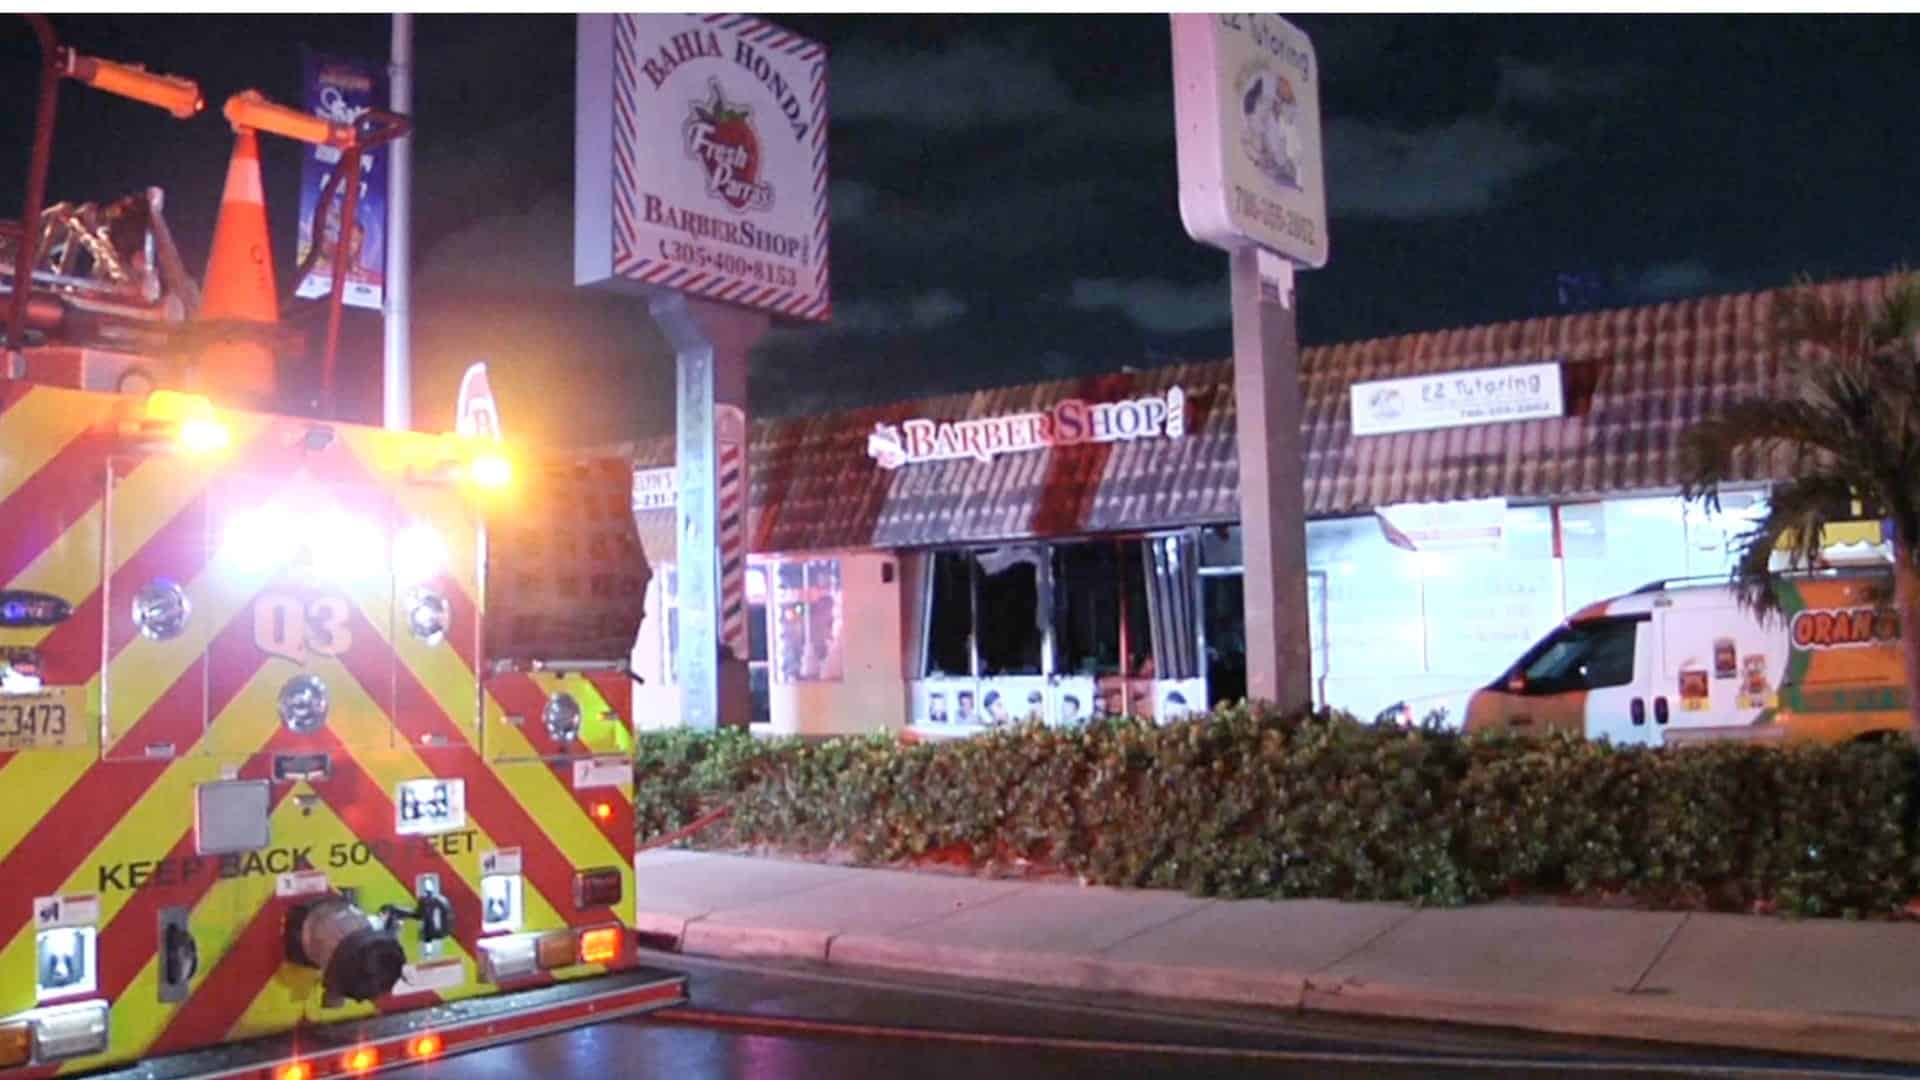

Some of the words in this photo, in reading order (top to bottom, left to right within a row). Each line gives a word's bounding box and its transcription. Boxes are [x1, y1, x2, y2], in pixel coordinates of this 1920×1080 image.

[642, 28, 723, 90] BAHIA
[735, 40, 809, 142] HONDA
[1421, 382, 1446, 402] EZ
[1455, 373, 1542, 396] Tutoring
[254, 595, 352, 667] Q3
[1793, 610, 1903, 647] ORAN
[99, 858, 206, 893] KEEP
[217, 846, 315, 880] BACK
[328, 835, 393, 869] 500
[411, 830, 478, 859] FEET
